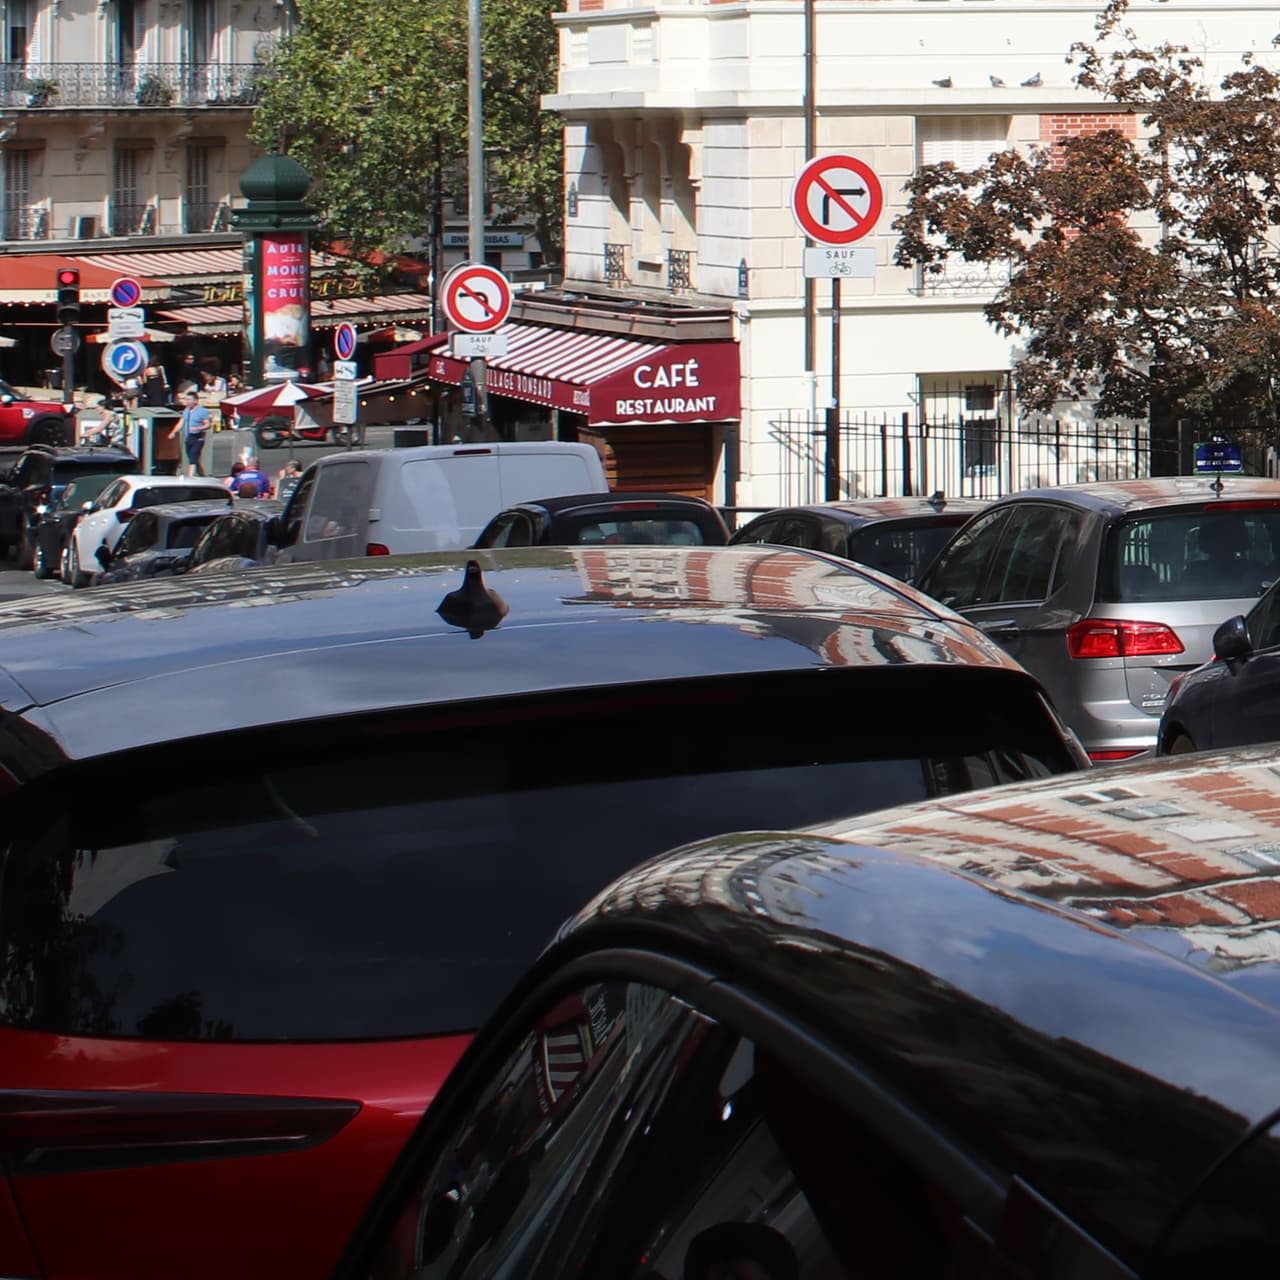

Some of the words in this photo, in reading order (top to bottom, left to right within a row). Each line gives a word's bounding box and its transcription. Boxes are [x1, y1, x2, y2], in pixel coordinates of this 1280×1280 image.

[826, 250, 855, 259] SAUF
[486, 369, 514, 390] ILLAGE
[633, 359, 699, 388] CAFÉ
[616, 396, 716, 415] RESTAURANT
